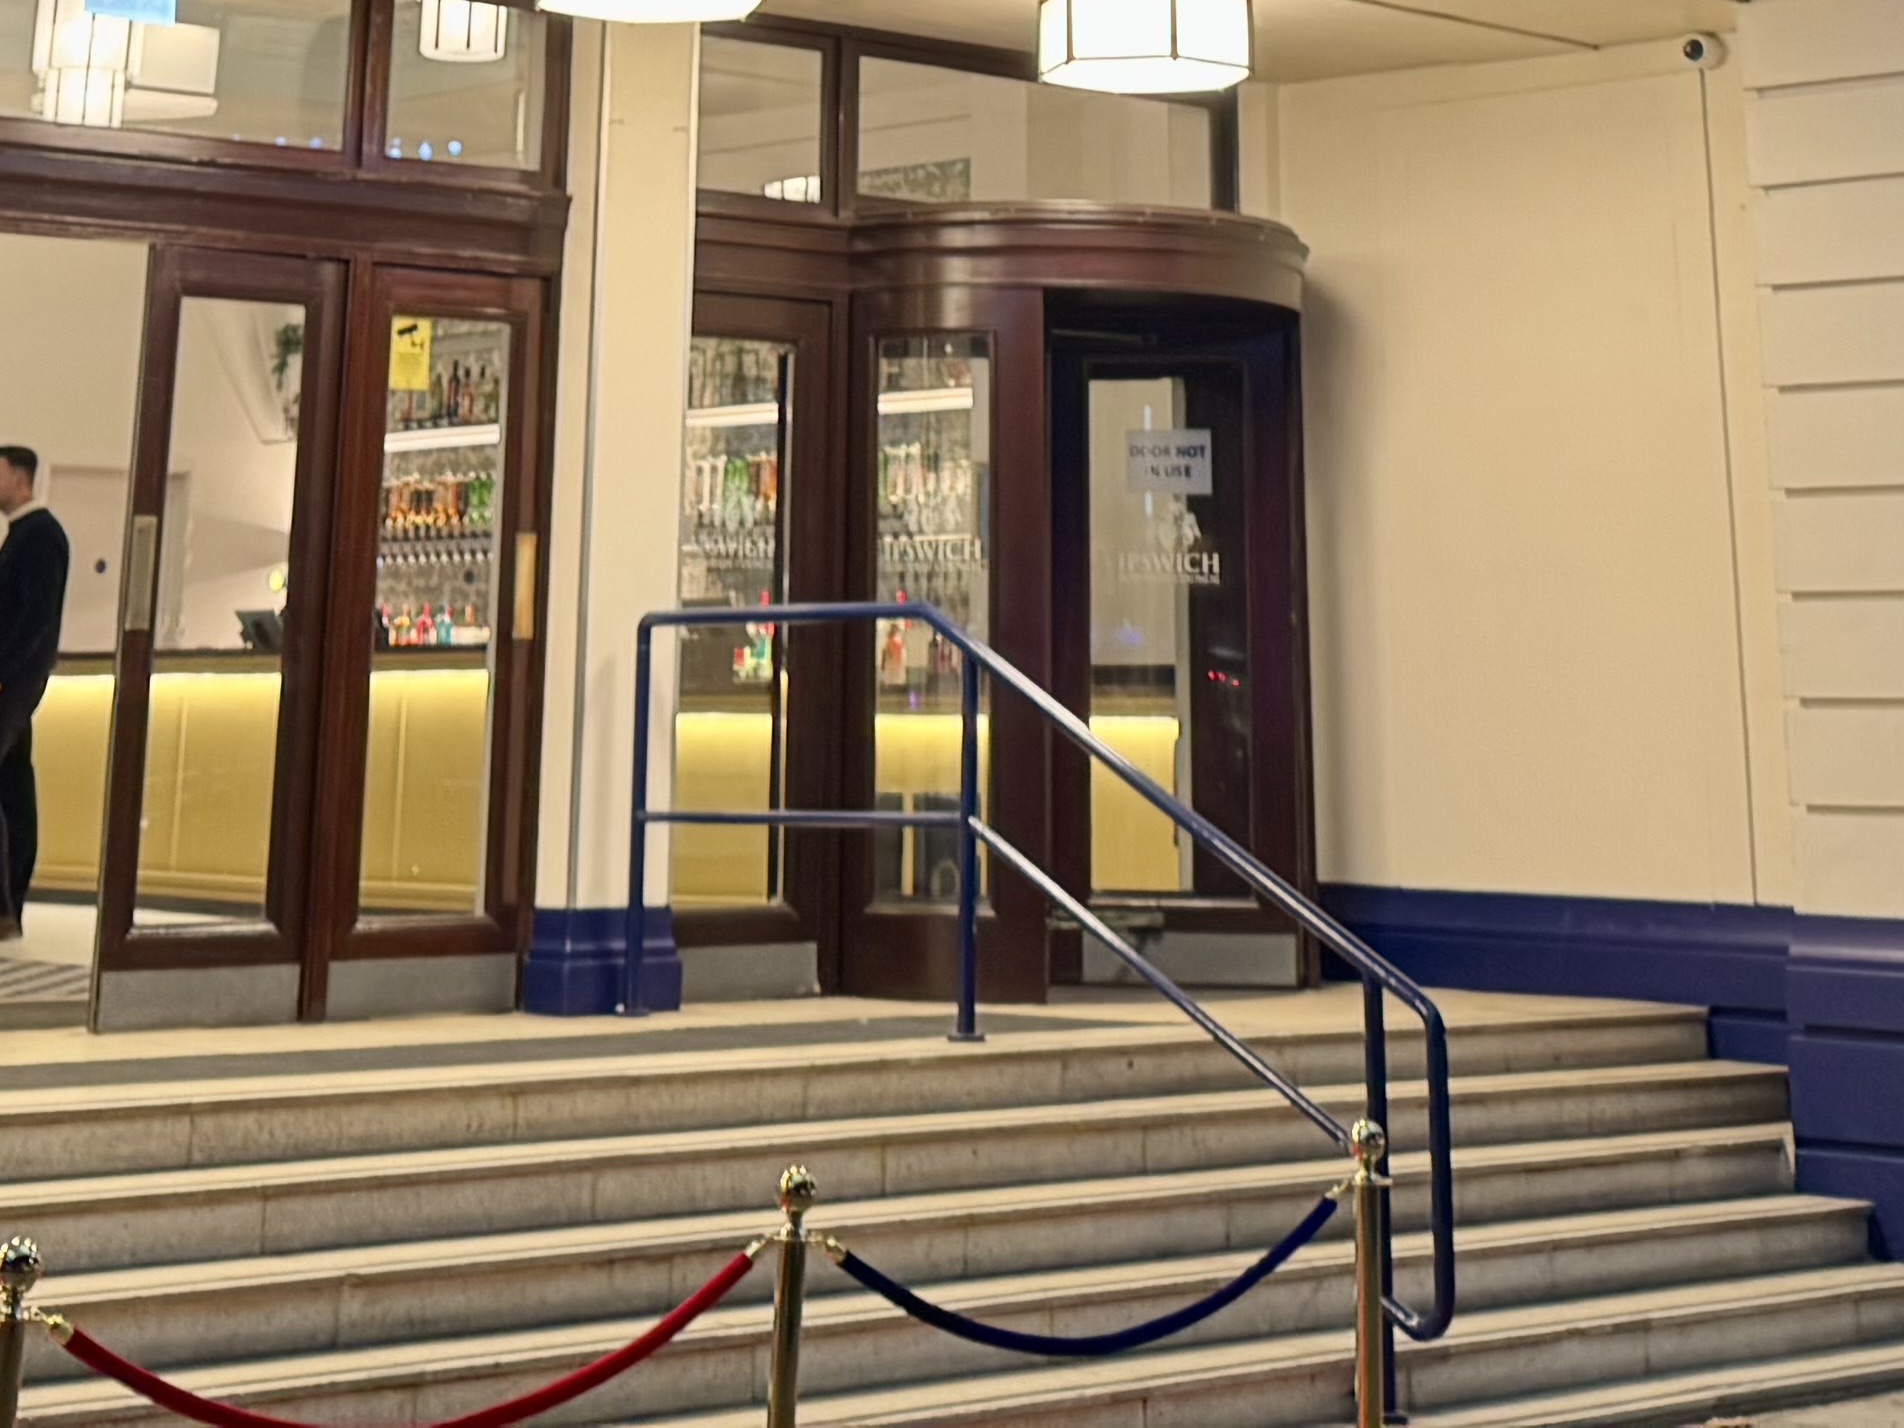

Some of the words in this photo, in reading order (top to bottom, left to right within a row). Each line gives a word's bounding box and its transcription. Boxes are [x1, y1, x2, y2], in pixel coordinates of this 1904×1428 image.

[1129, 445, 1171, 458] DOOR
[1175, 445, 1206, 459] NOT
[1165, 465, 1192, 478] USE
[884, 538, 981, 562] IPSWICH
[1118, 551, 1220, 574] IPSWICH
